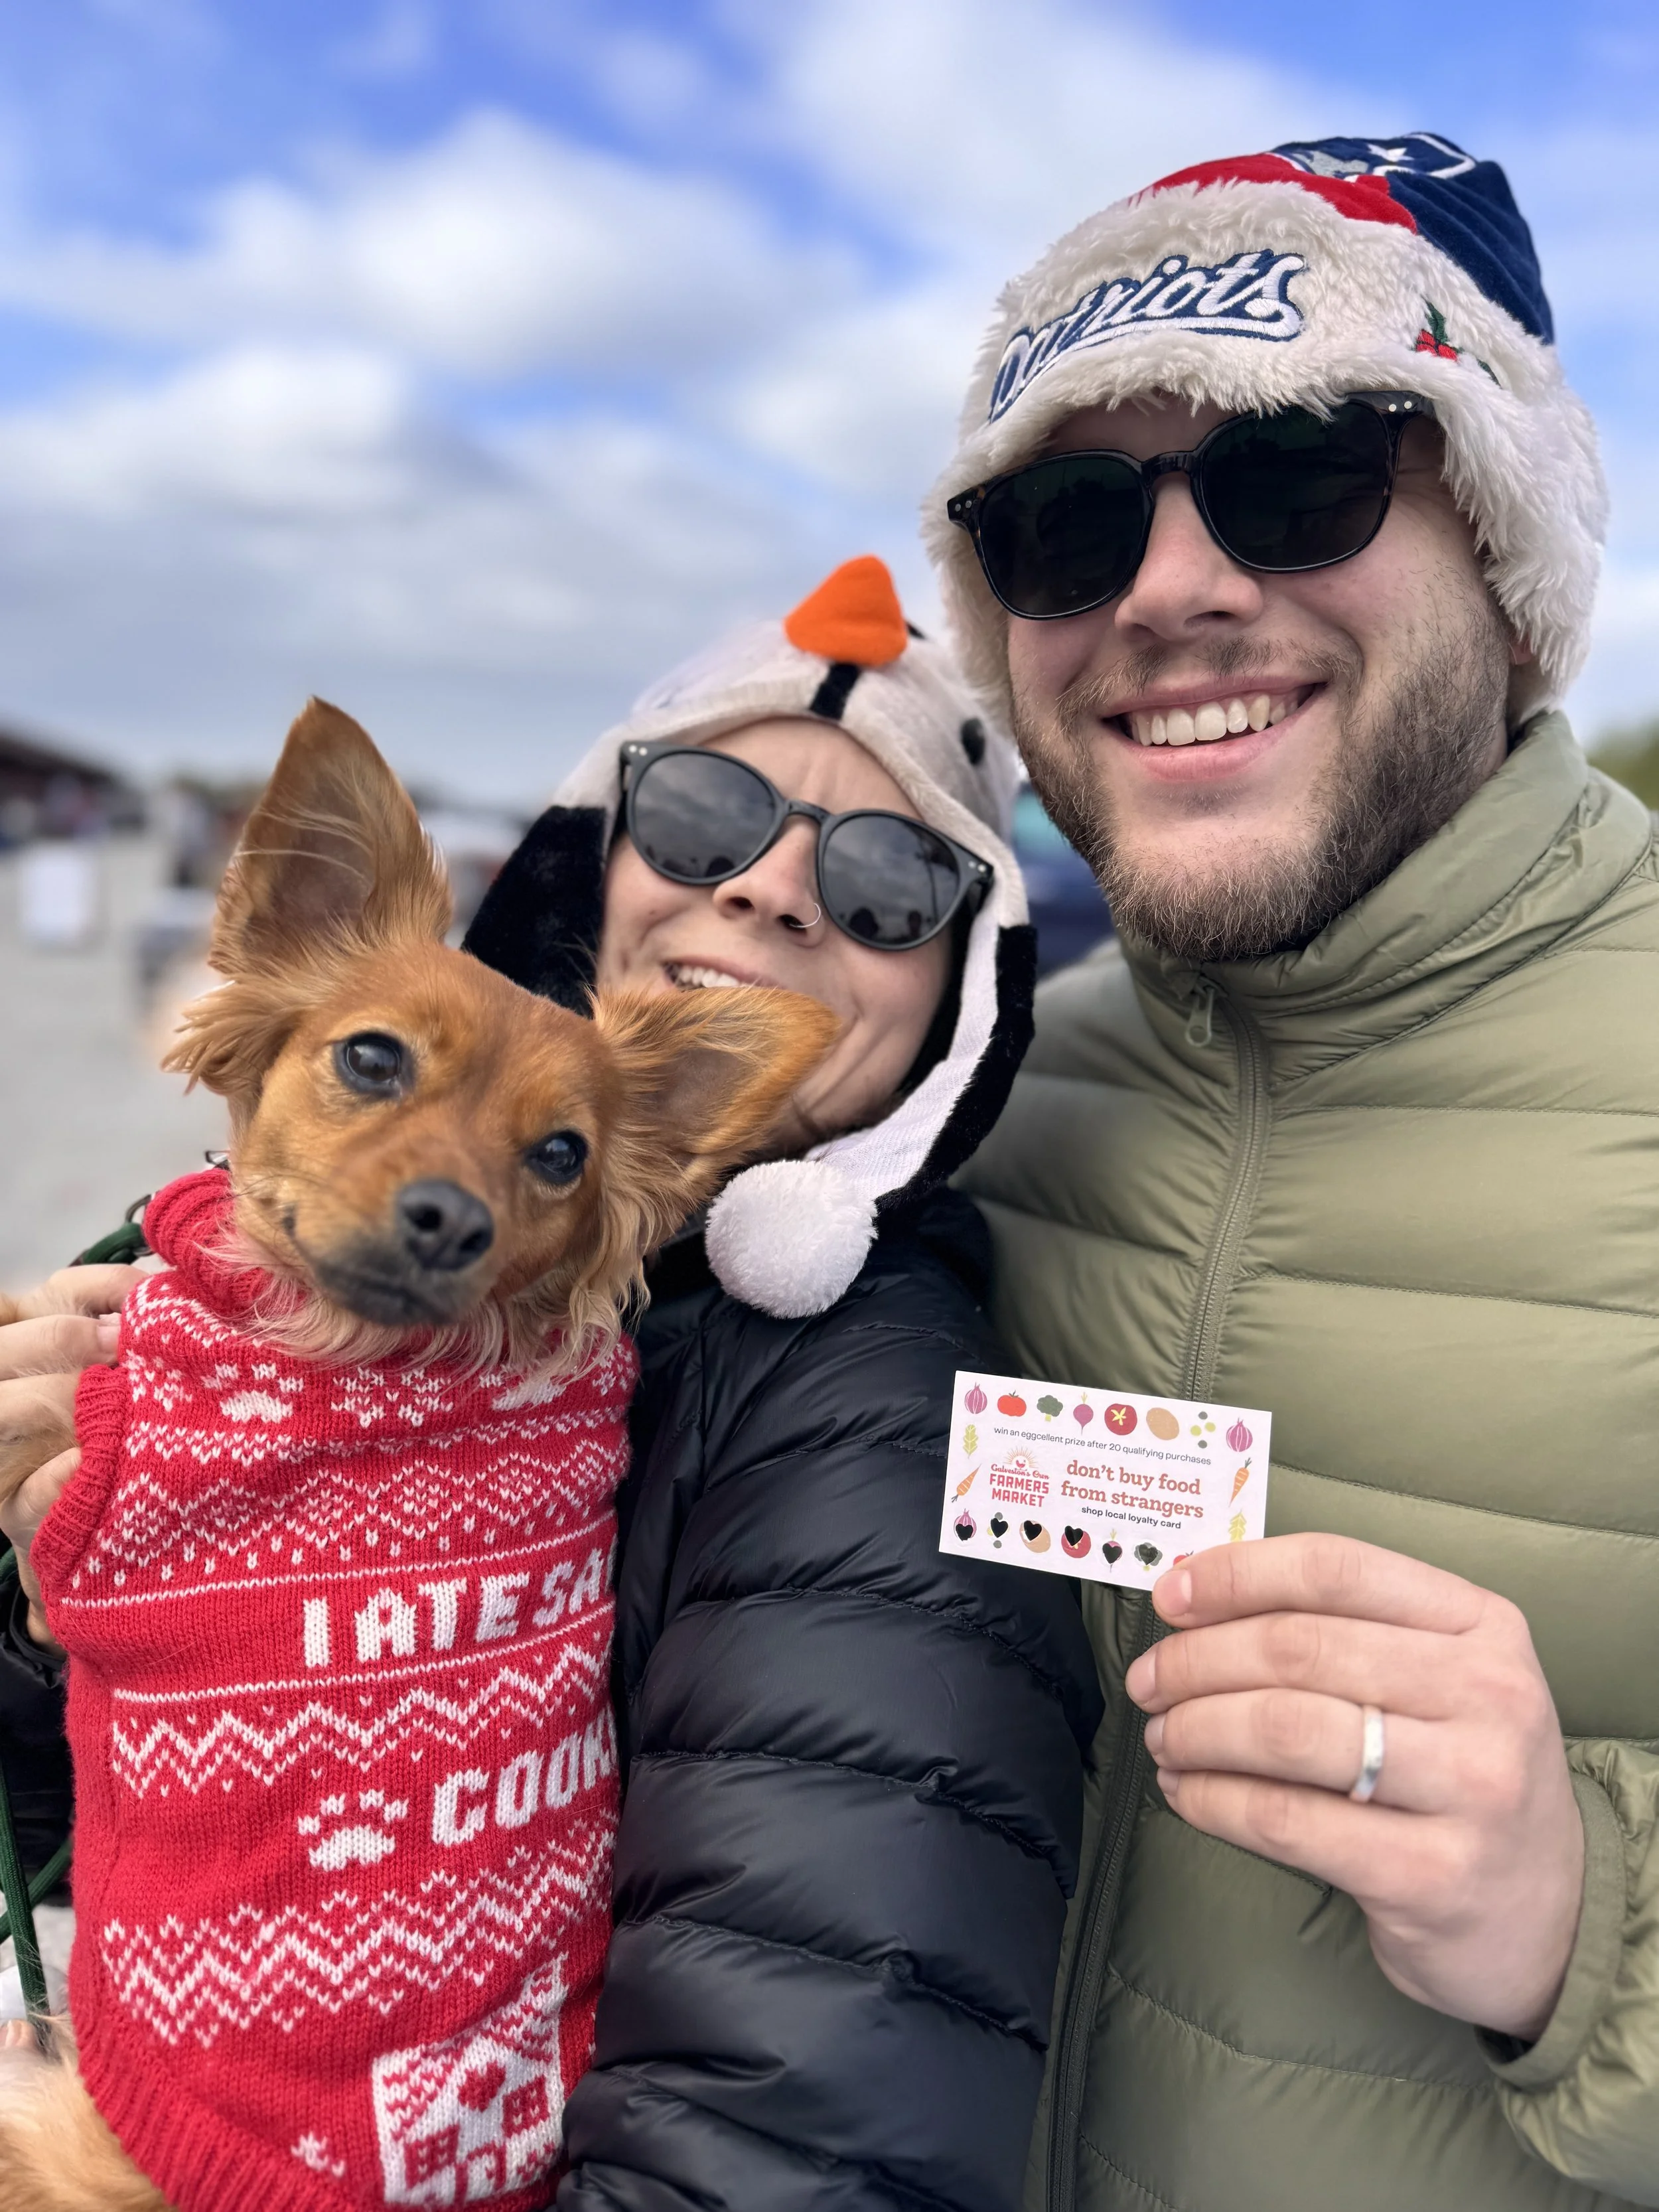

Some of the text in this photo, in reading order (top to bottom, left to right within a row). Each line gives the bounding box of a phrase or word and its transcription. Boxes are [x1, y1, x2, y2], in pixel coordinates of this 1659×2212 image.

[1021, 1432, 1063, 1443] eggcellent
[1064, 1438, 1085, 1447] prize
[1087, 1441, 1107, 1449] after
[1110, 1443, 1121, 1451] 20
[1123, 1445, 1163, 1459] qualifying
[1166, 1452, 1211, 1465] purchases
[989, 1473, 1049, 1494] FARMERS
[991, 1463, 1049, 1479] Galveston's Own
[1067, 1460, 1201, 1495] don't buy food
[991, 1488, 1045, 1507] MARKET
[1061, 1480, 1204, 1518] from strangers
[1082, 1507, 1181, 1528] shop local loyalty card
[303, 1533, 618, 1668] I ATE SA
